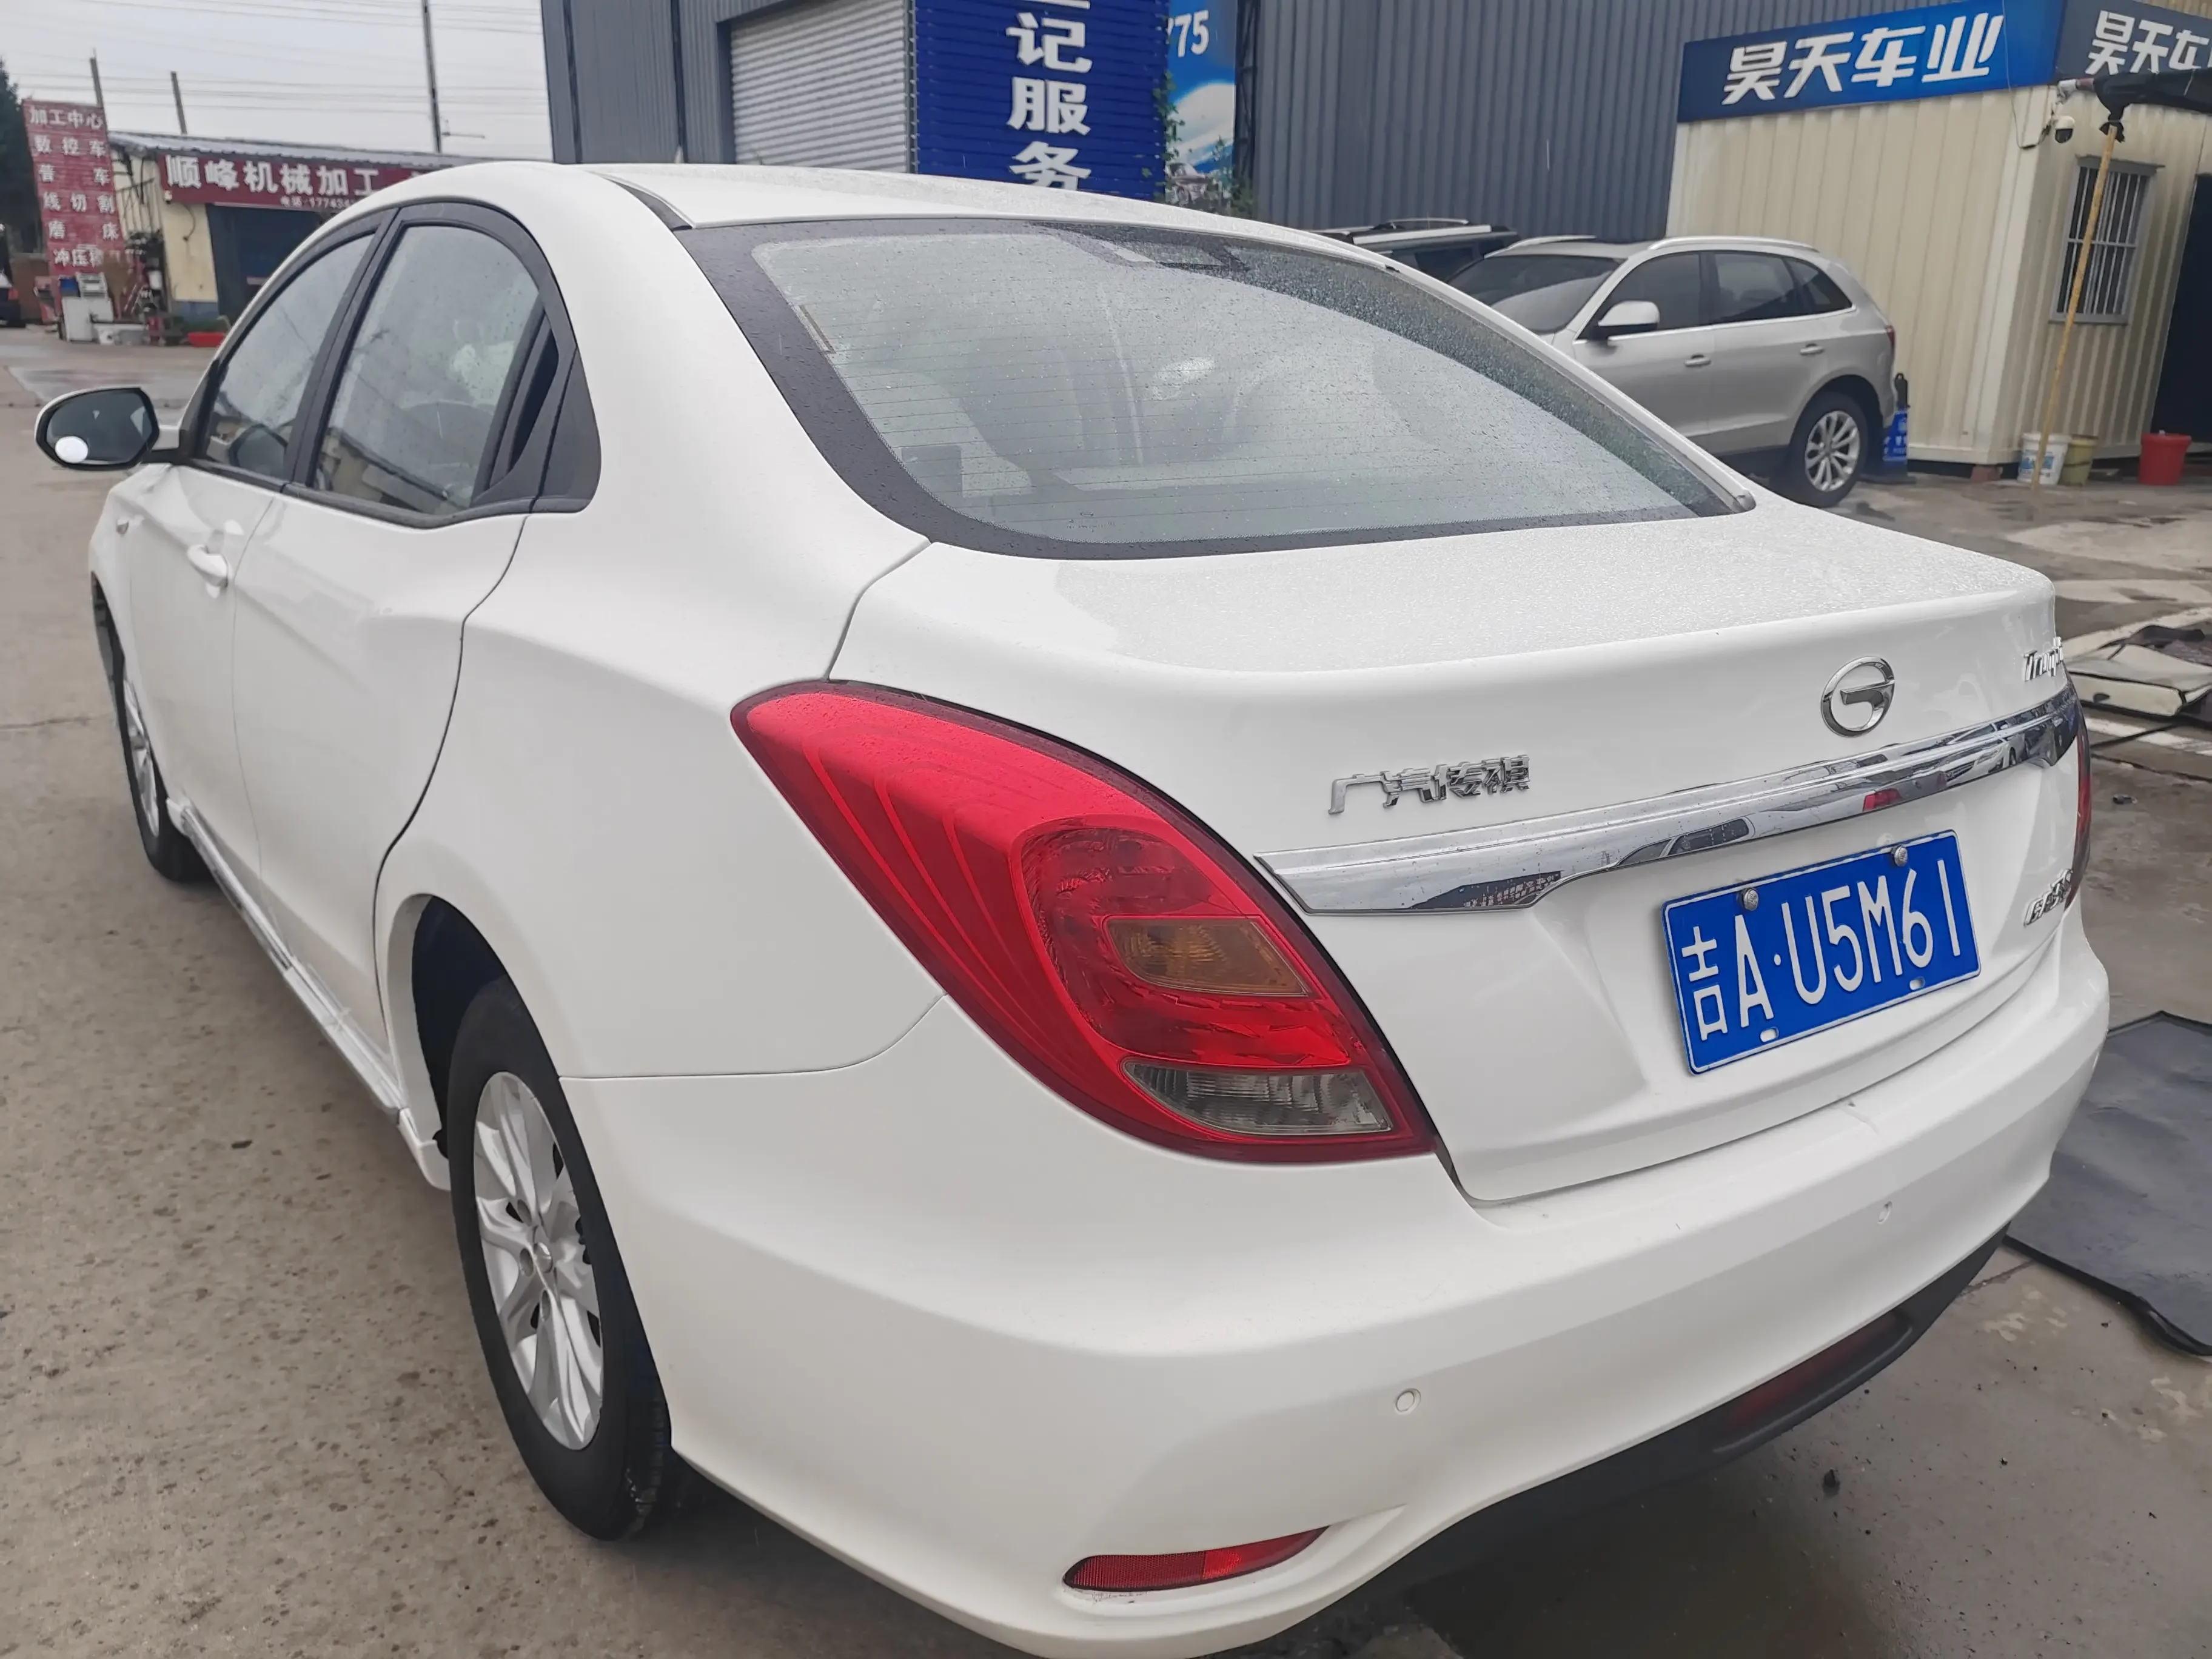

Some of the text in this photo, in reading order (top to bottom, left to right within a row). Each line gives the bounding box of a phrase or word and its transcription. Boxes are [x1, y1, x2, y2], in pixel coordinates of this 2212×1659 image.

[1721, 12, 2005, 106] 昊天车业
[2085, 10, 2212, 75] 昊天车
[29, 106, 103, 130] 加工中心
[1004, 0, 1093, 190] 记服务
[166, 154, 380, 196] 顺峰机械加工
